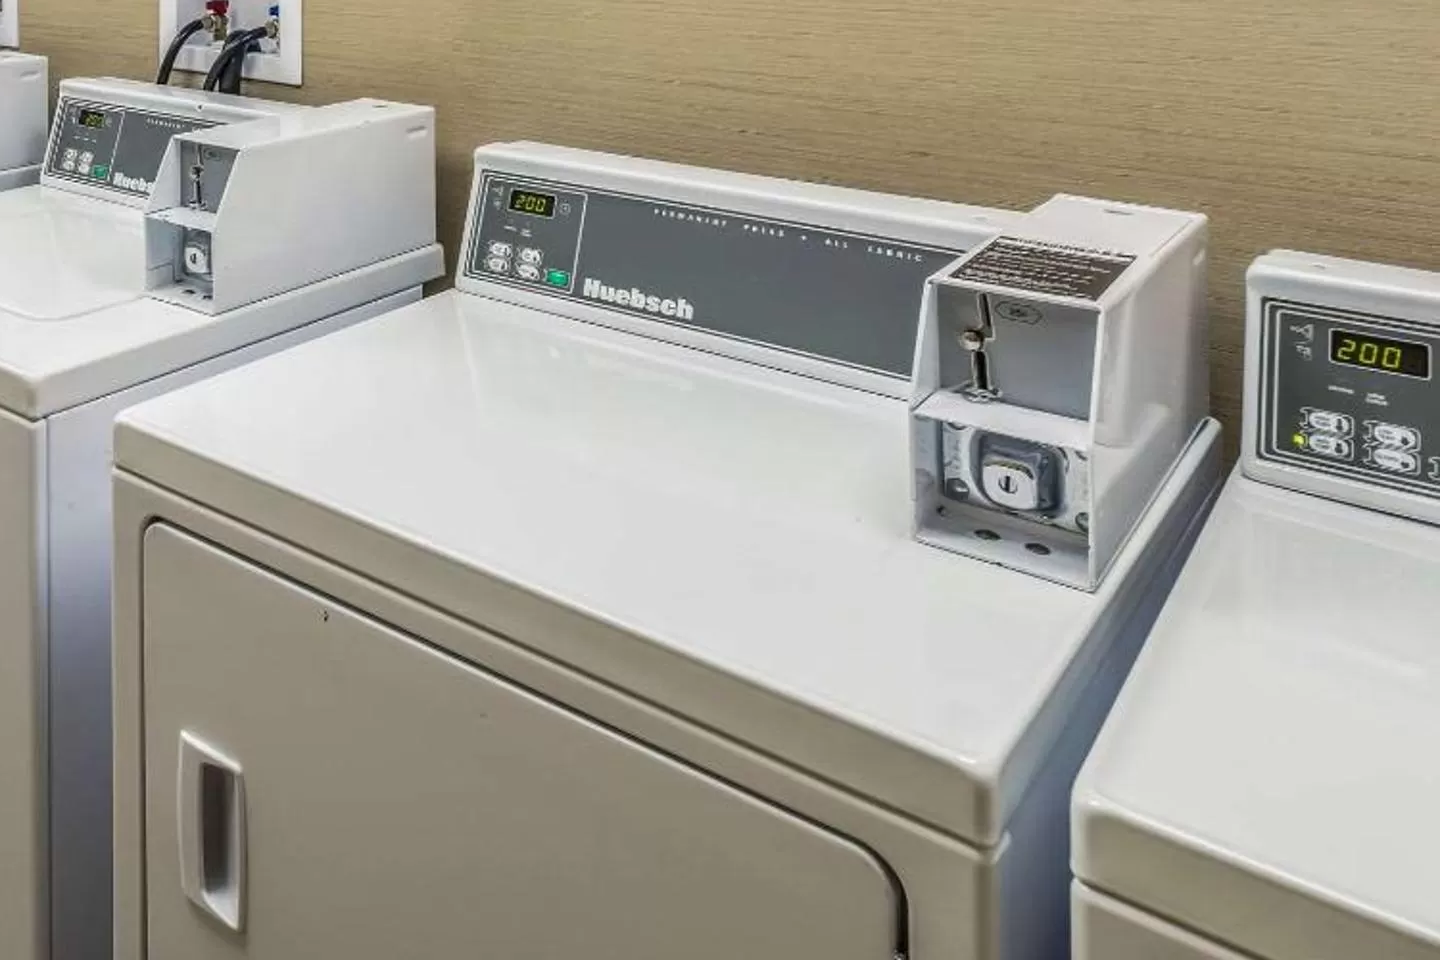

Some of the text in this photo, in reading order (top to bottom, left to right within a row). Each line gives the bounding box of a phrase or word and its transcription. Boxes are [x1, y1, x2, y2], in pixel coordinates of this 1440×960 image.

[513, 193, 547, 213] 200
[582, 277, 695, 320] Huebsch
[1337, 339, 1402, 369] 200
